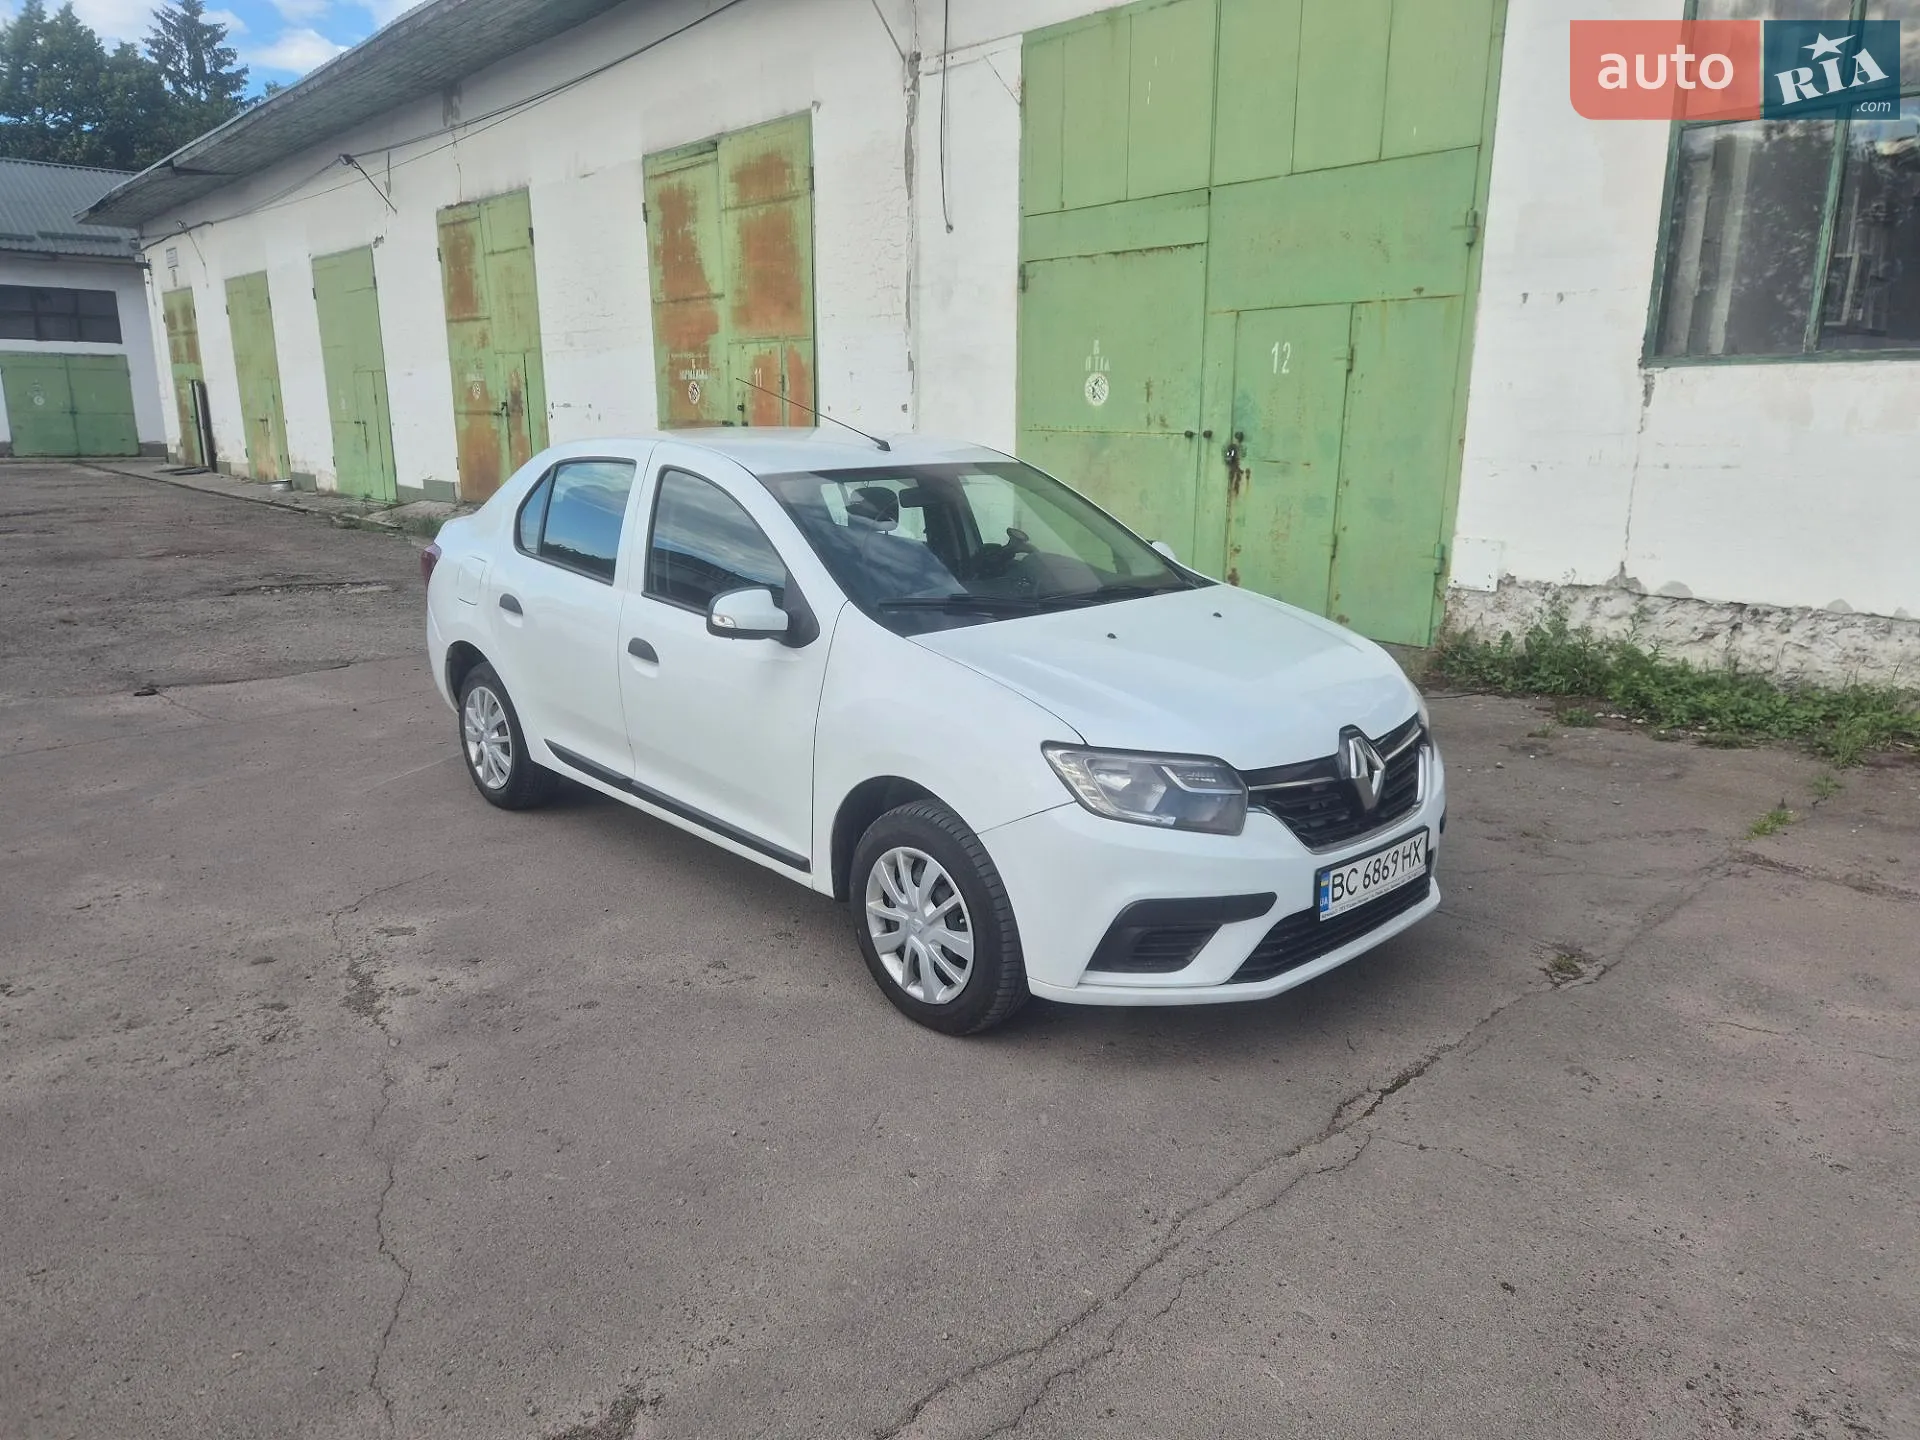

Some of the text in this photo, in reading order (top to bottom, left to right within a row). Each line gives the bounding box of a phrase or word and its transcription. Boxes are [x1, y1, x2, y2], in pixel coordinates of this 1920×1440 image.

[1271, 342, 1291, 374] 12
[754, 367, 762, 387] 11
[1331, 867, 1358, 903] BC
[1362, 850, 1400, 890] 6869
[1401, 837, 1423, 873] HX
